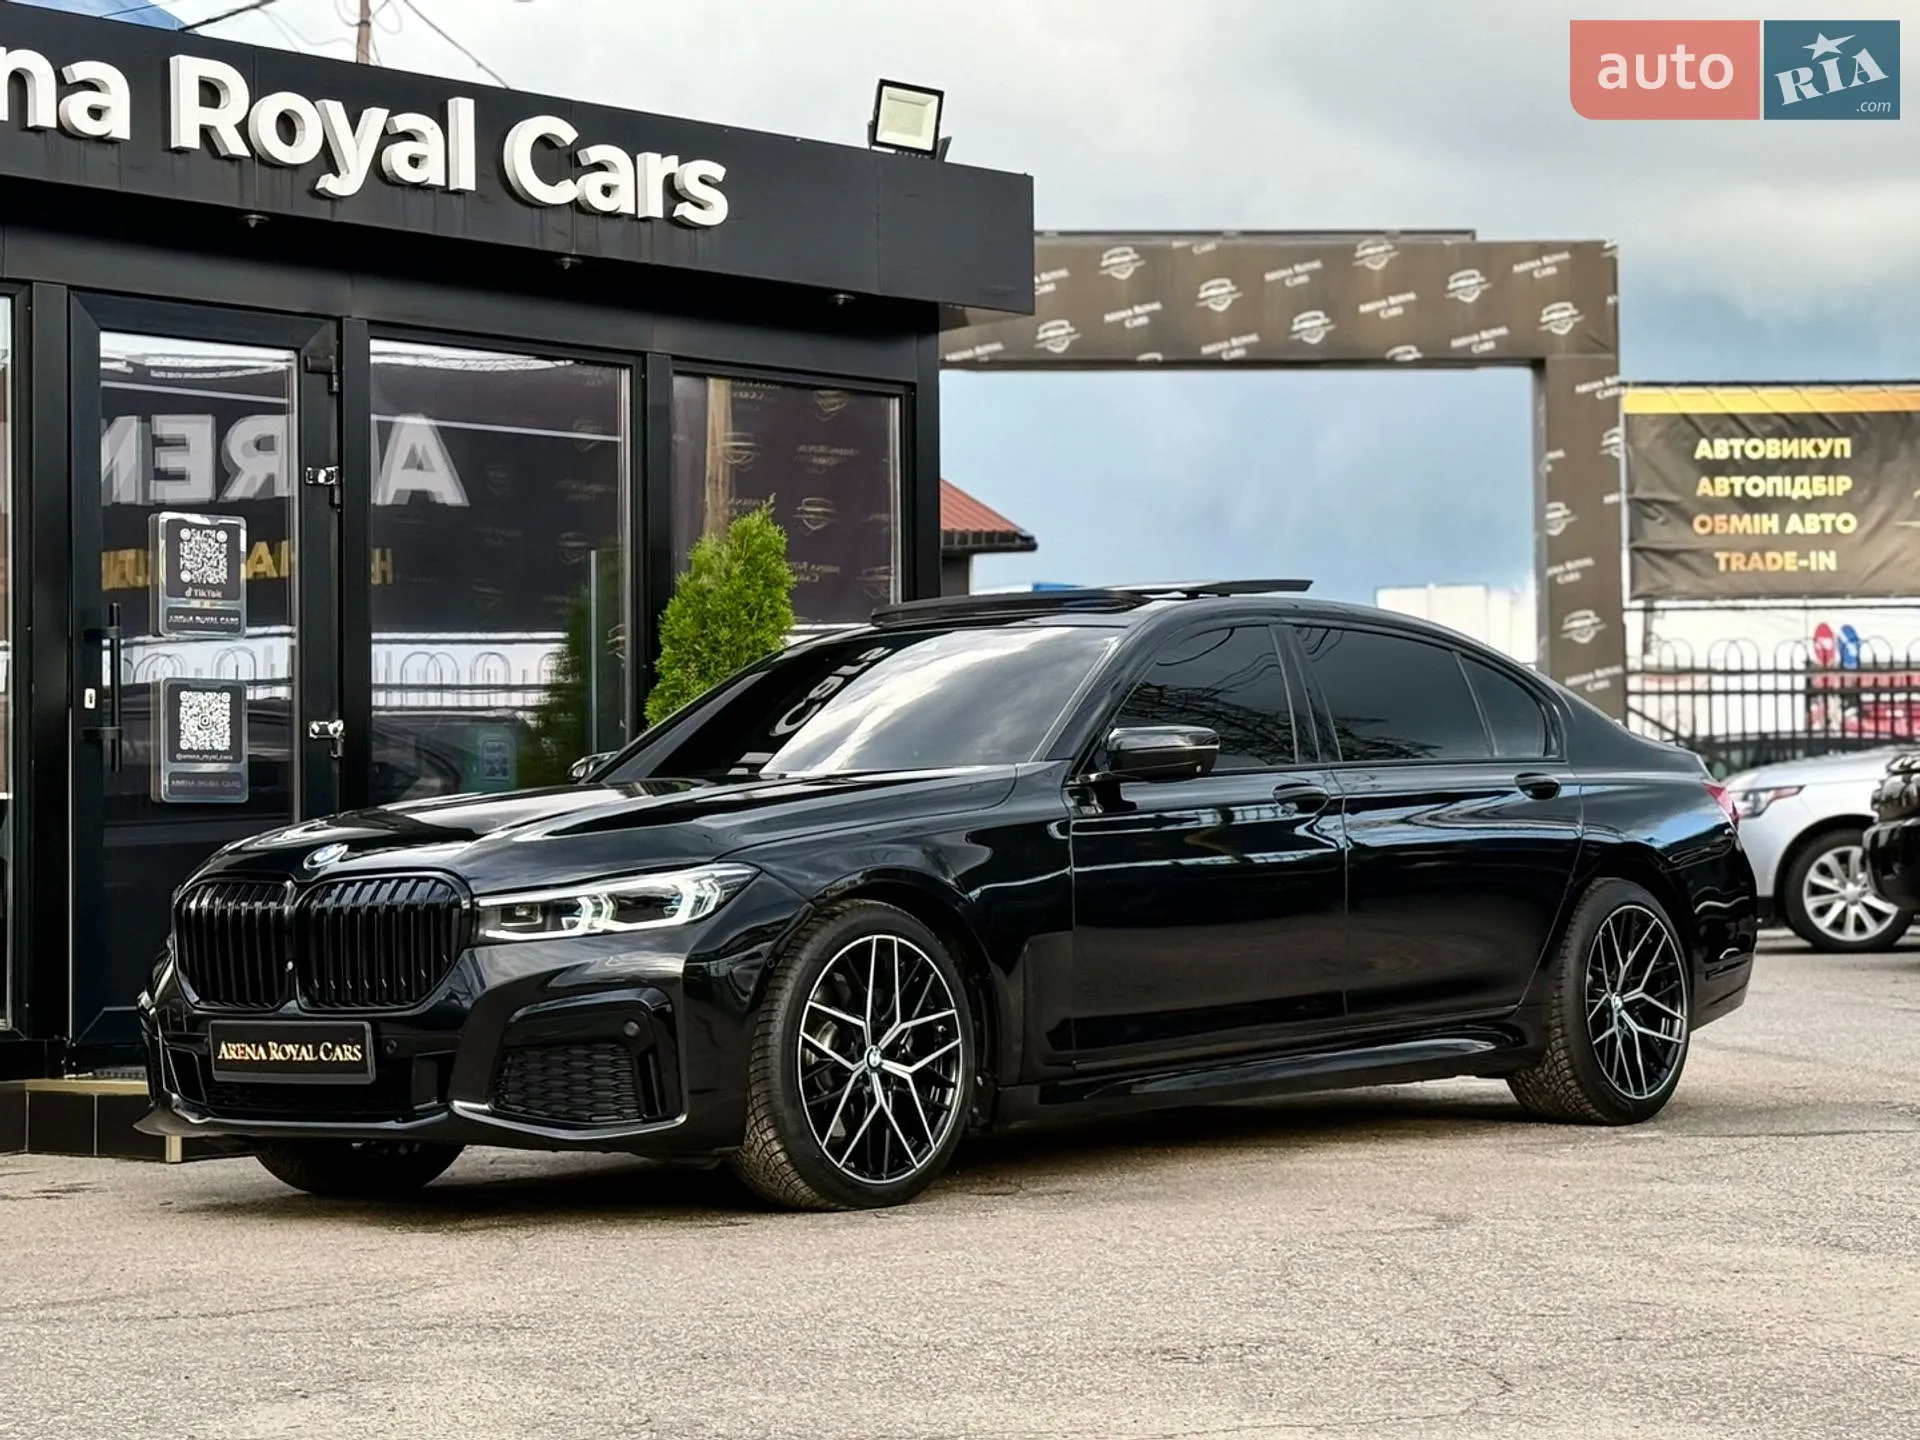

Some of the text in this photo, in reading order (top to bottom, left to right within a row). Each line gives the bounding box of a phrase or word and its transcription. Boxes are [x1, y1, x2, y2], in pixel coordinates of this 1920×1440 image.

[169, 55, 477, 198] Royal
[503, 115, 729, 228] Cars
[1694, 438, 1851, 460] АВТОВИКУП
[1696, 475, 1853, 500] АВТОПІДБІР
[1692, 513, 1857, 535] ОБМІН АВТО
[1714, 550, 1837, 573] TRADE-IN
[217, 1040, 362, 1062] ARENA ROYAL CARS
